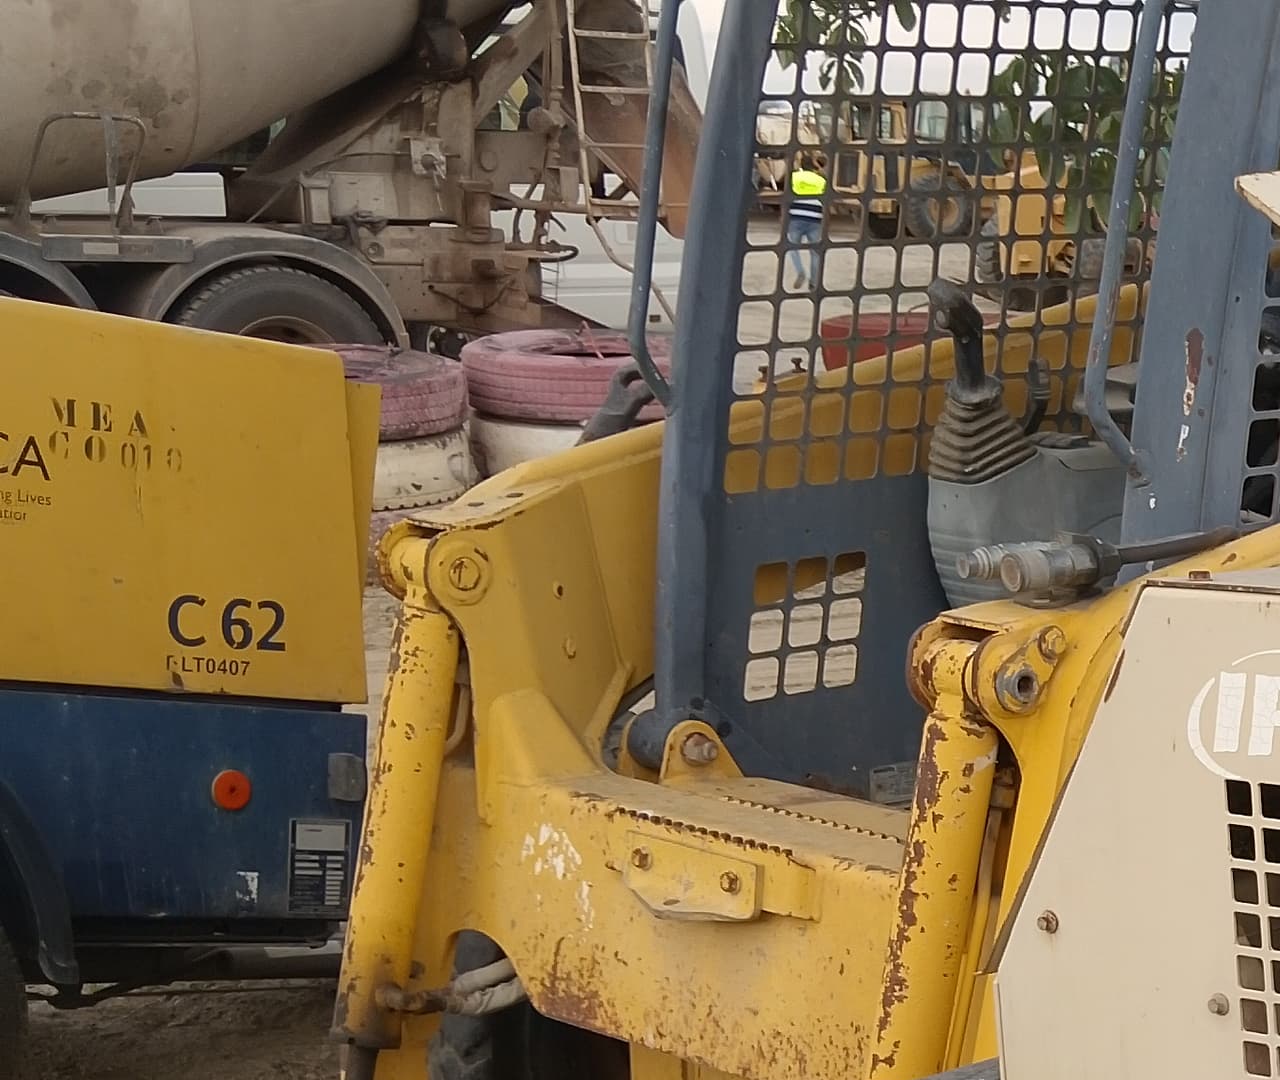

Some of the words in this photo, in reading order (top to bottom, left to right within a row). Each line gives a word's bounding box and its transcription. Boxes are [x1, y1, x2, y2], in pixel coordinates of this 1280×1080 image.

[17, 489, 52, 506] Lives
[167, 595, 207, 648] C
[220, 598, 287, 652] 62
